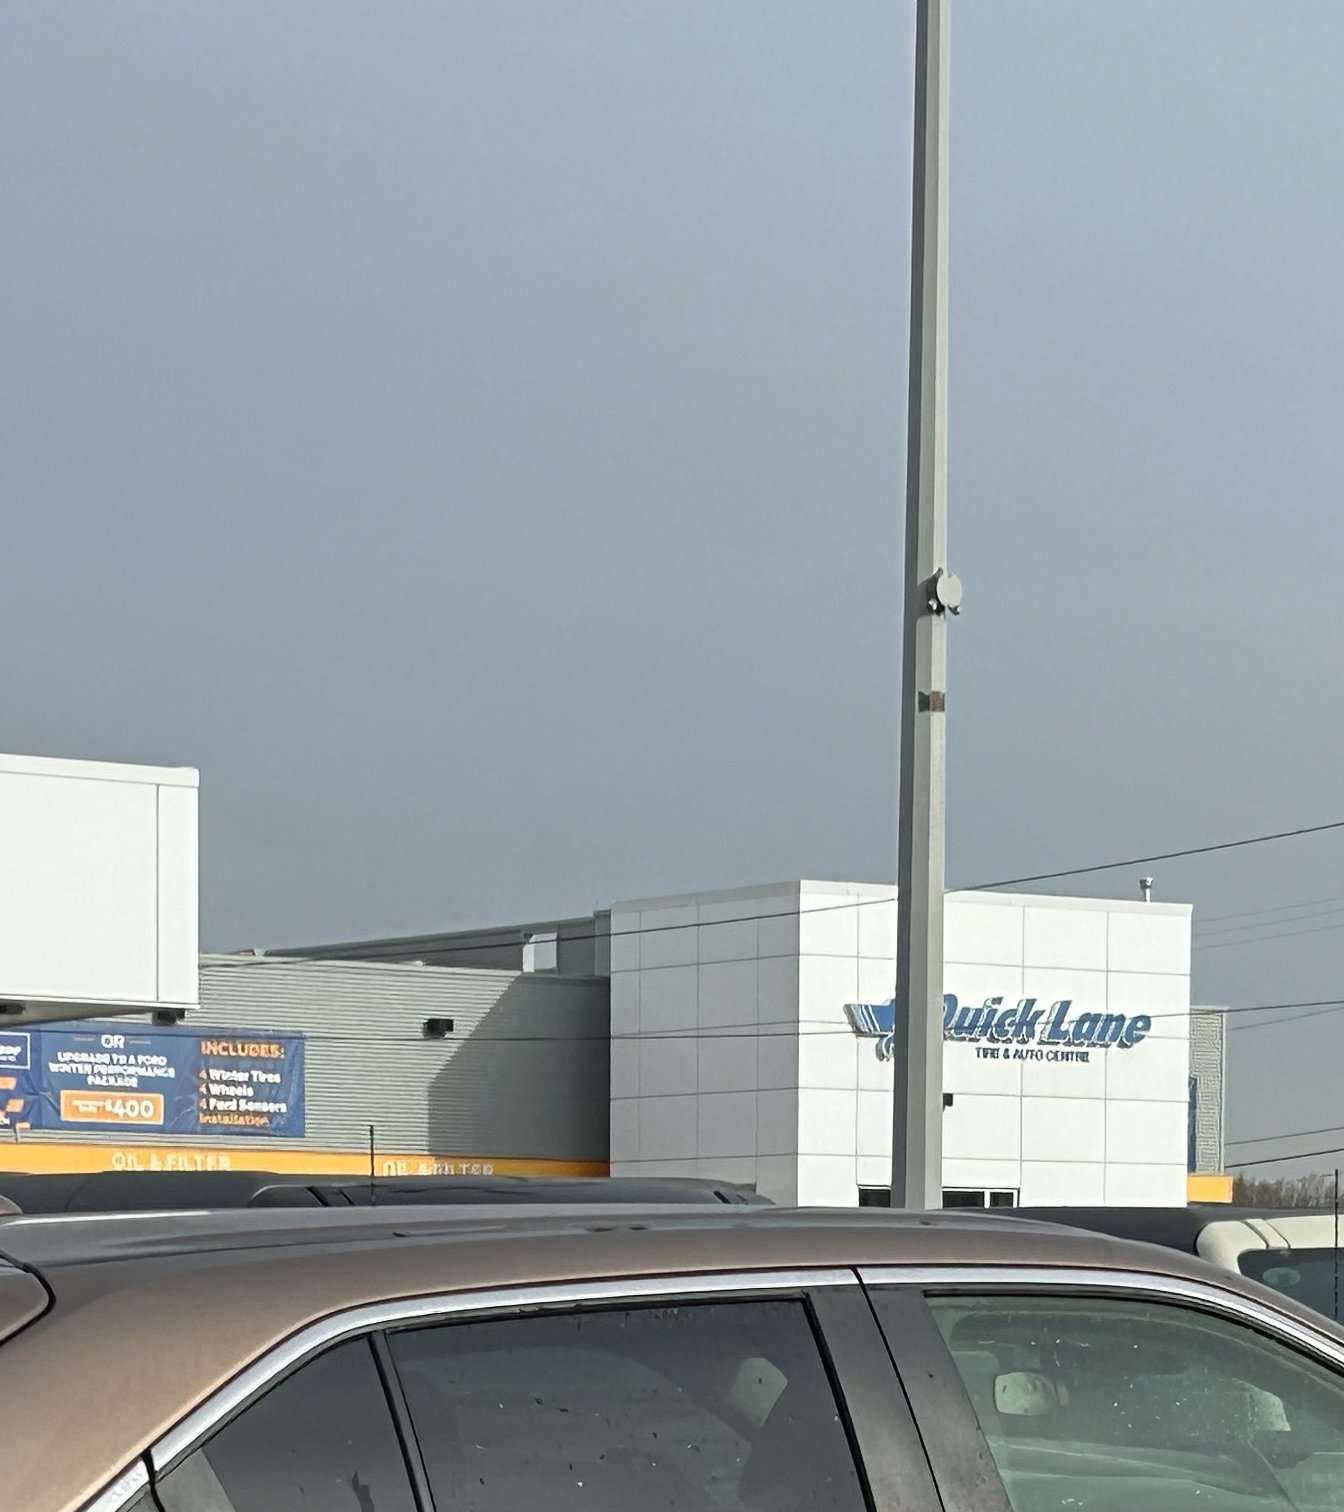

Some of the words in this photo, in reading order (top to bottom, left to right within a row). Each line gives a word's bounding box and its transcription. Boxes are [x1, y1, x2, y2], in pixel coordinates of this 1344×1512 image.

[1038, 1000, 1151, 1048] Lane
[101, 1034, 125, 1048] OR
[201, 1041, 285, 1059] INCLUDES:
[975, 1047, 999, 1059] TIRE
[1002, 1048, 1010, 1059] &
[1012, 1049, 1043, 1061] AUTO
[1045, 1050, 1090, 1062] CENTRE
[209, 1083, 254, 1097] Wheels
[105, 1098, 154, 1117] $400
